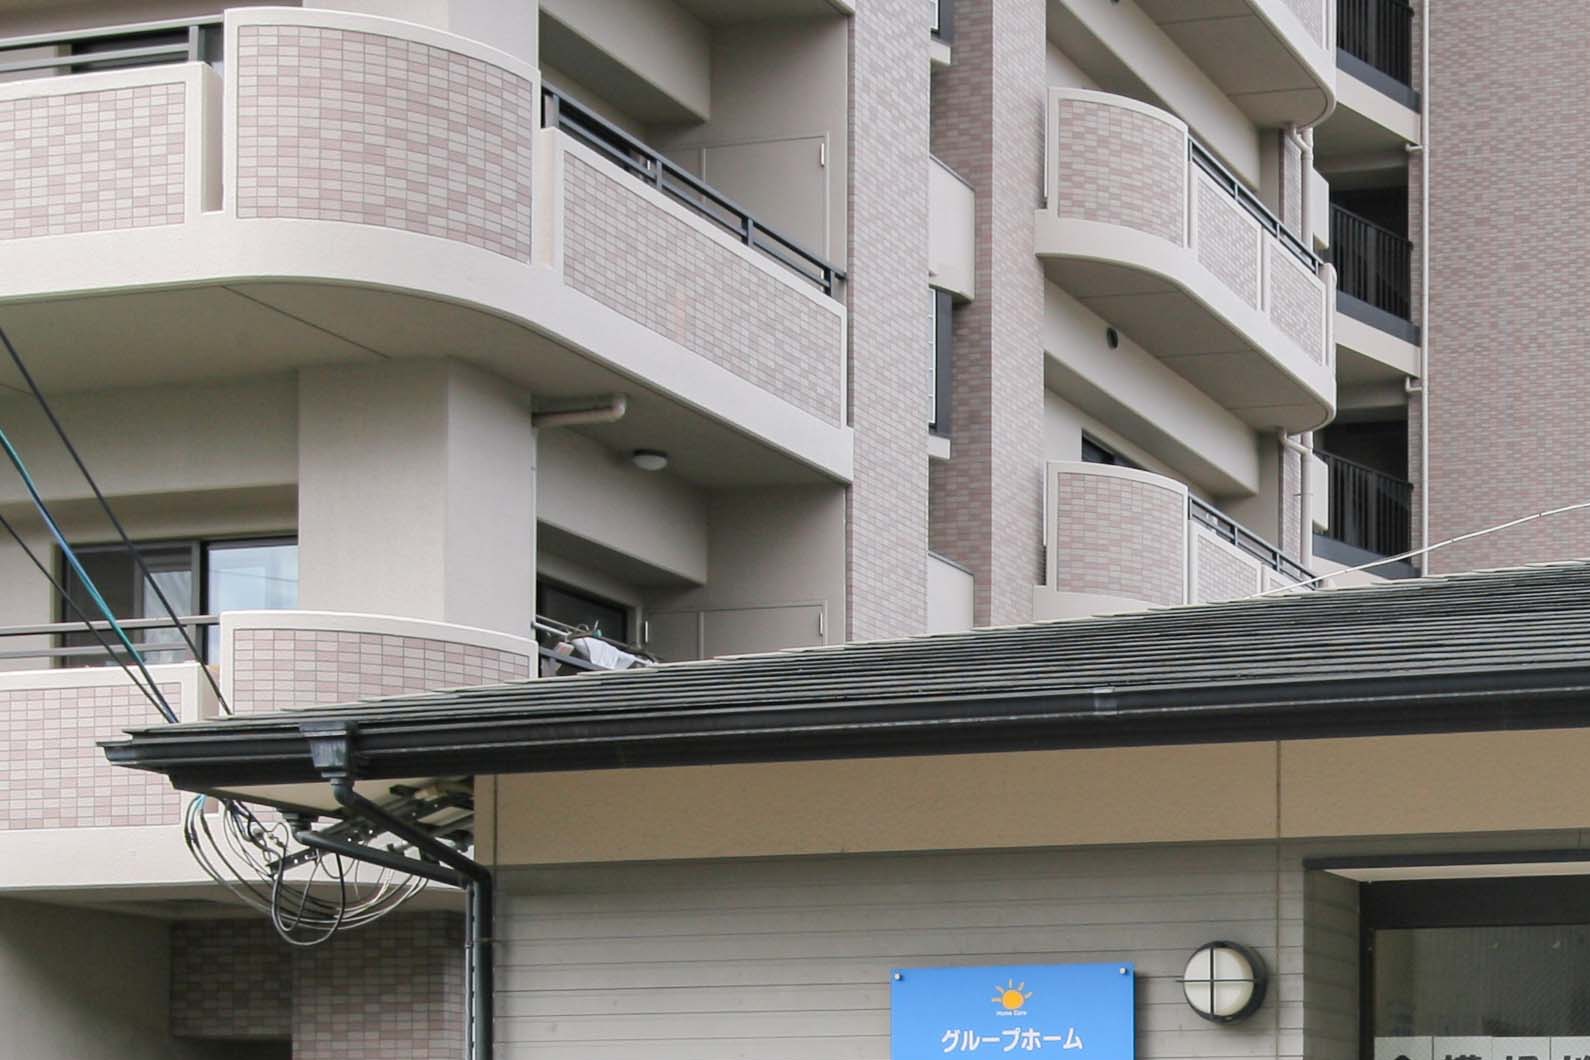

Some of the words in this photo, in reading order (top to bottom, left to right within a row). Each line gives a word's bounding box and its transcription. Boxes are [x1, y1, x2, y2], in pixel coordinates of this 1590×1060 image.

[941, 1027, 1083, 1053] グループホーム
